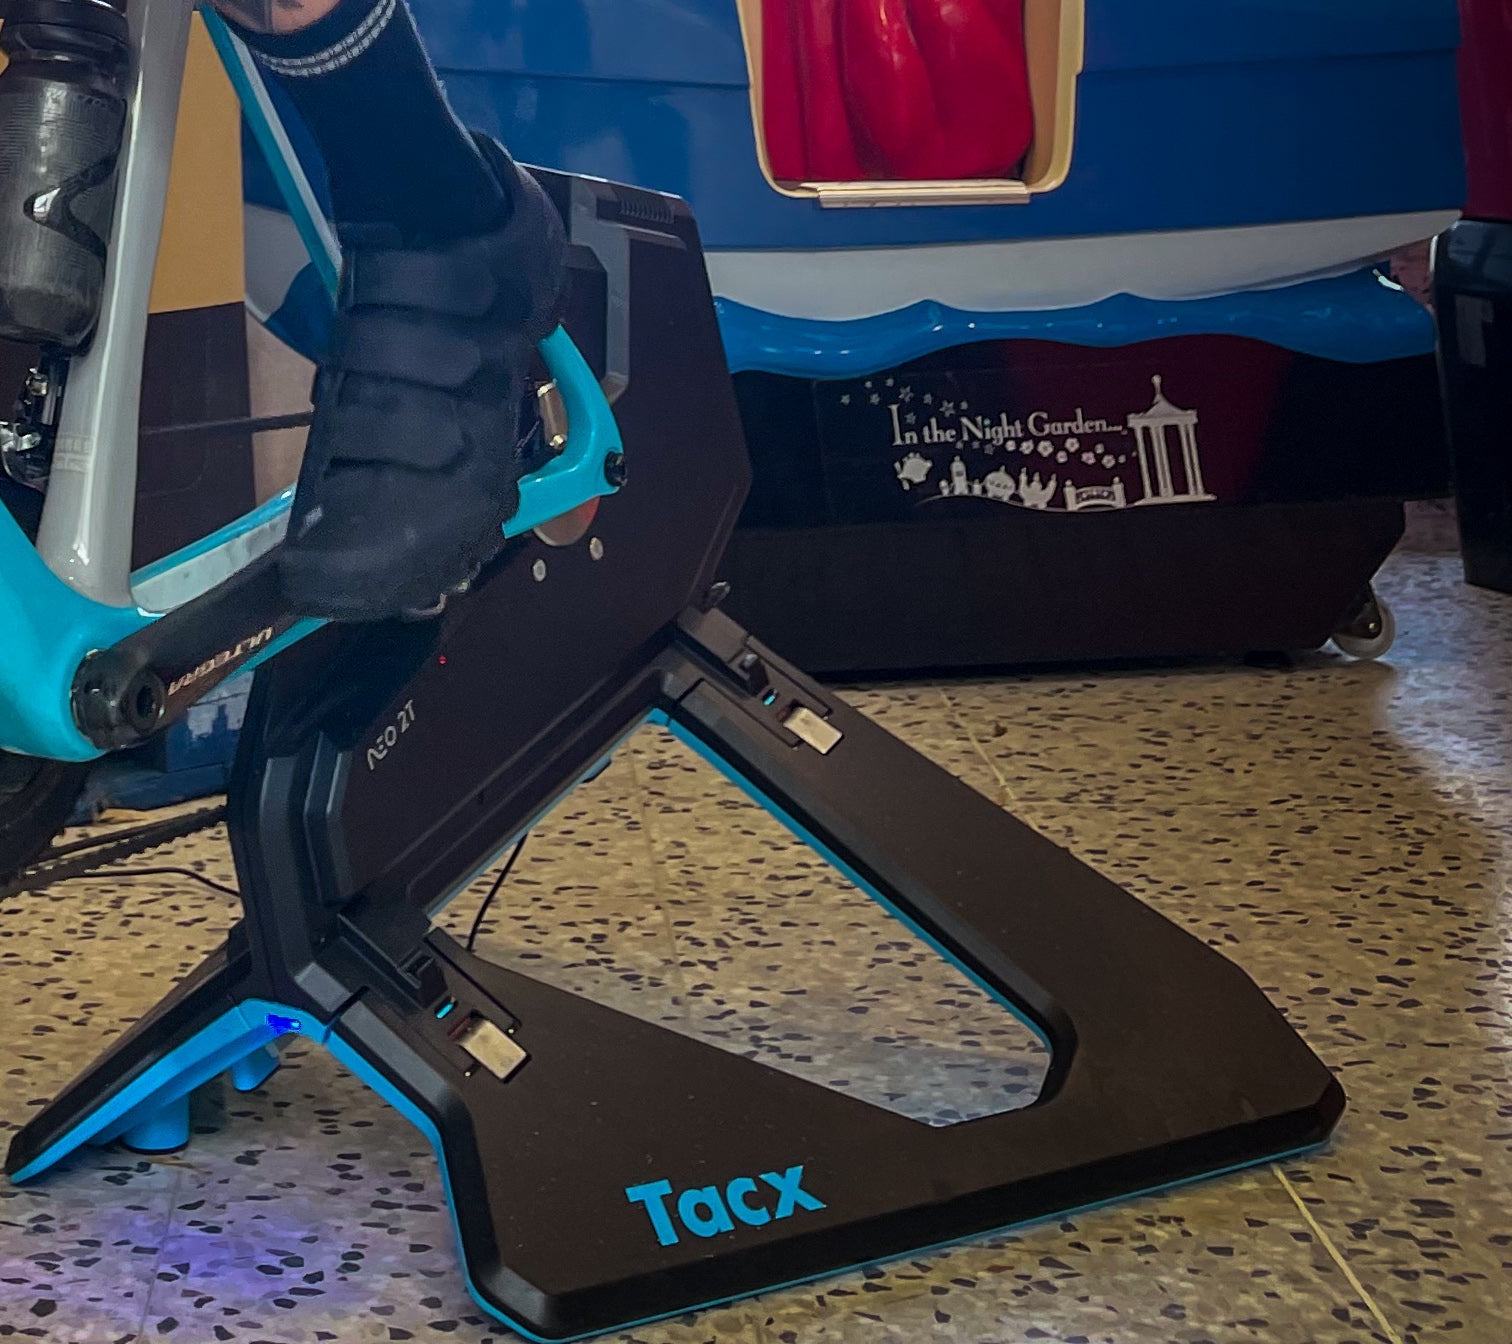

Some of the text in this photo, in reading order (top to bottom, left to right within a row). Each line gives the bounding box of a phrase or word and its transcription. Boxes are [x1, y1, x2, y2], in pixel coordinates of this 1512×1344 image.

[888, 402, 918, 447] In
[922, 417, 956, 444] the
[960, 413, 1024, 449] Night
[366, 724, 398, 771] NEO
[625, 1164, 827, 1247] Tacx
